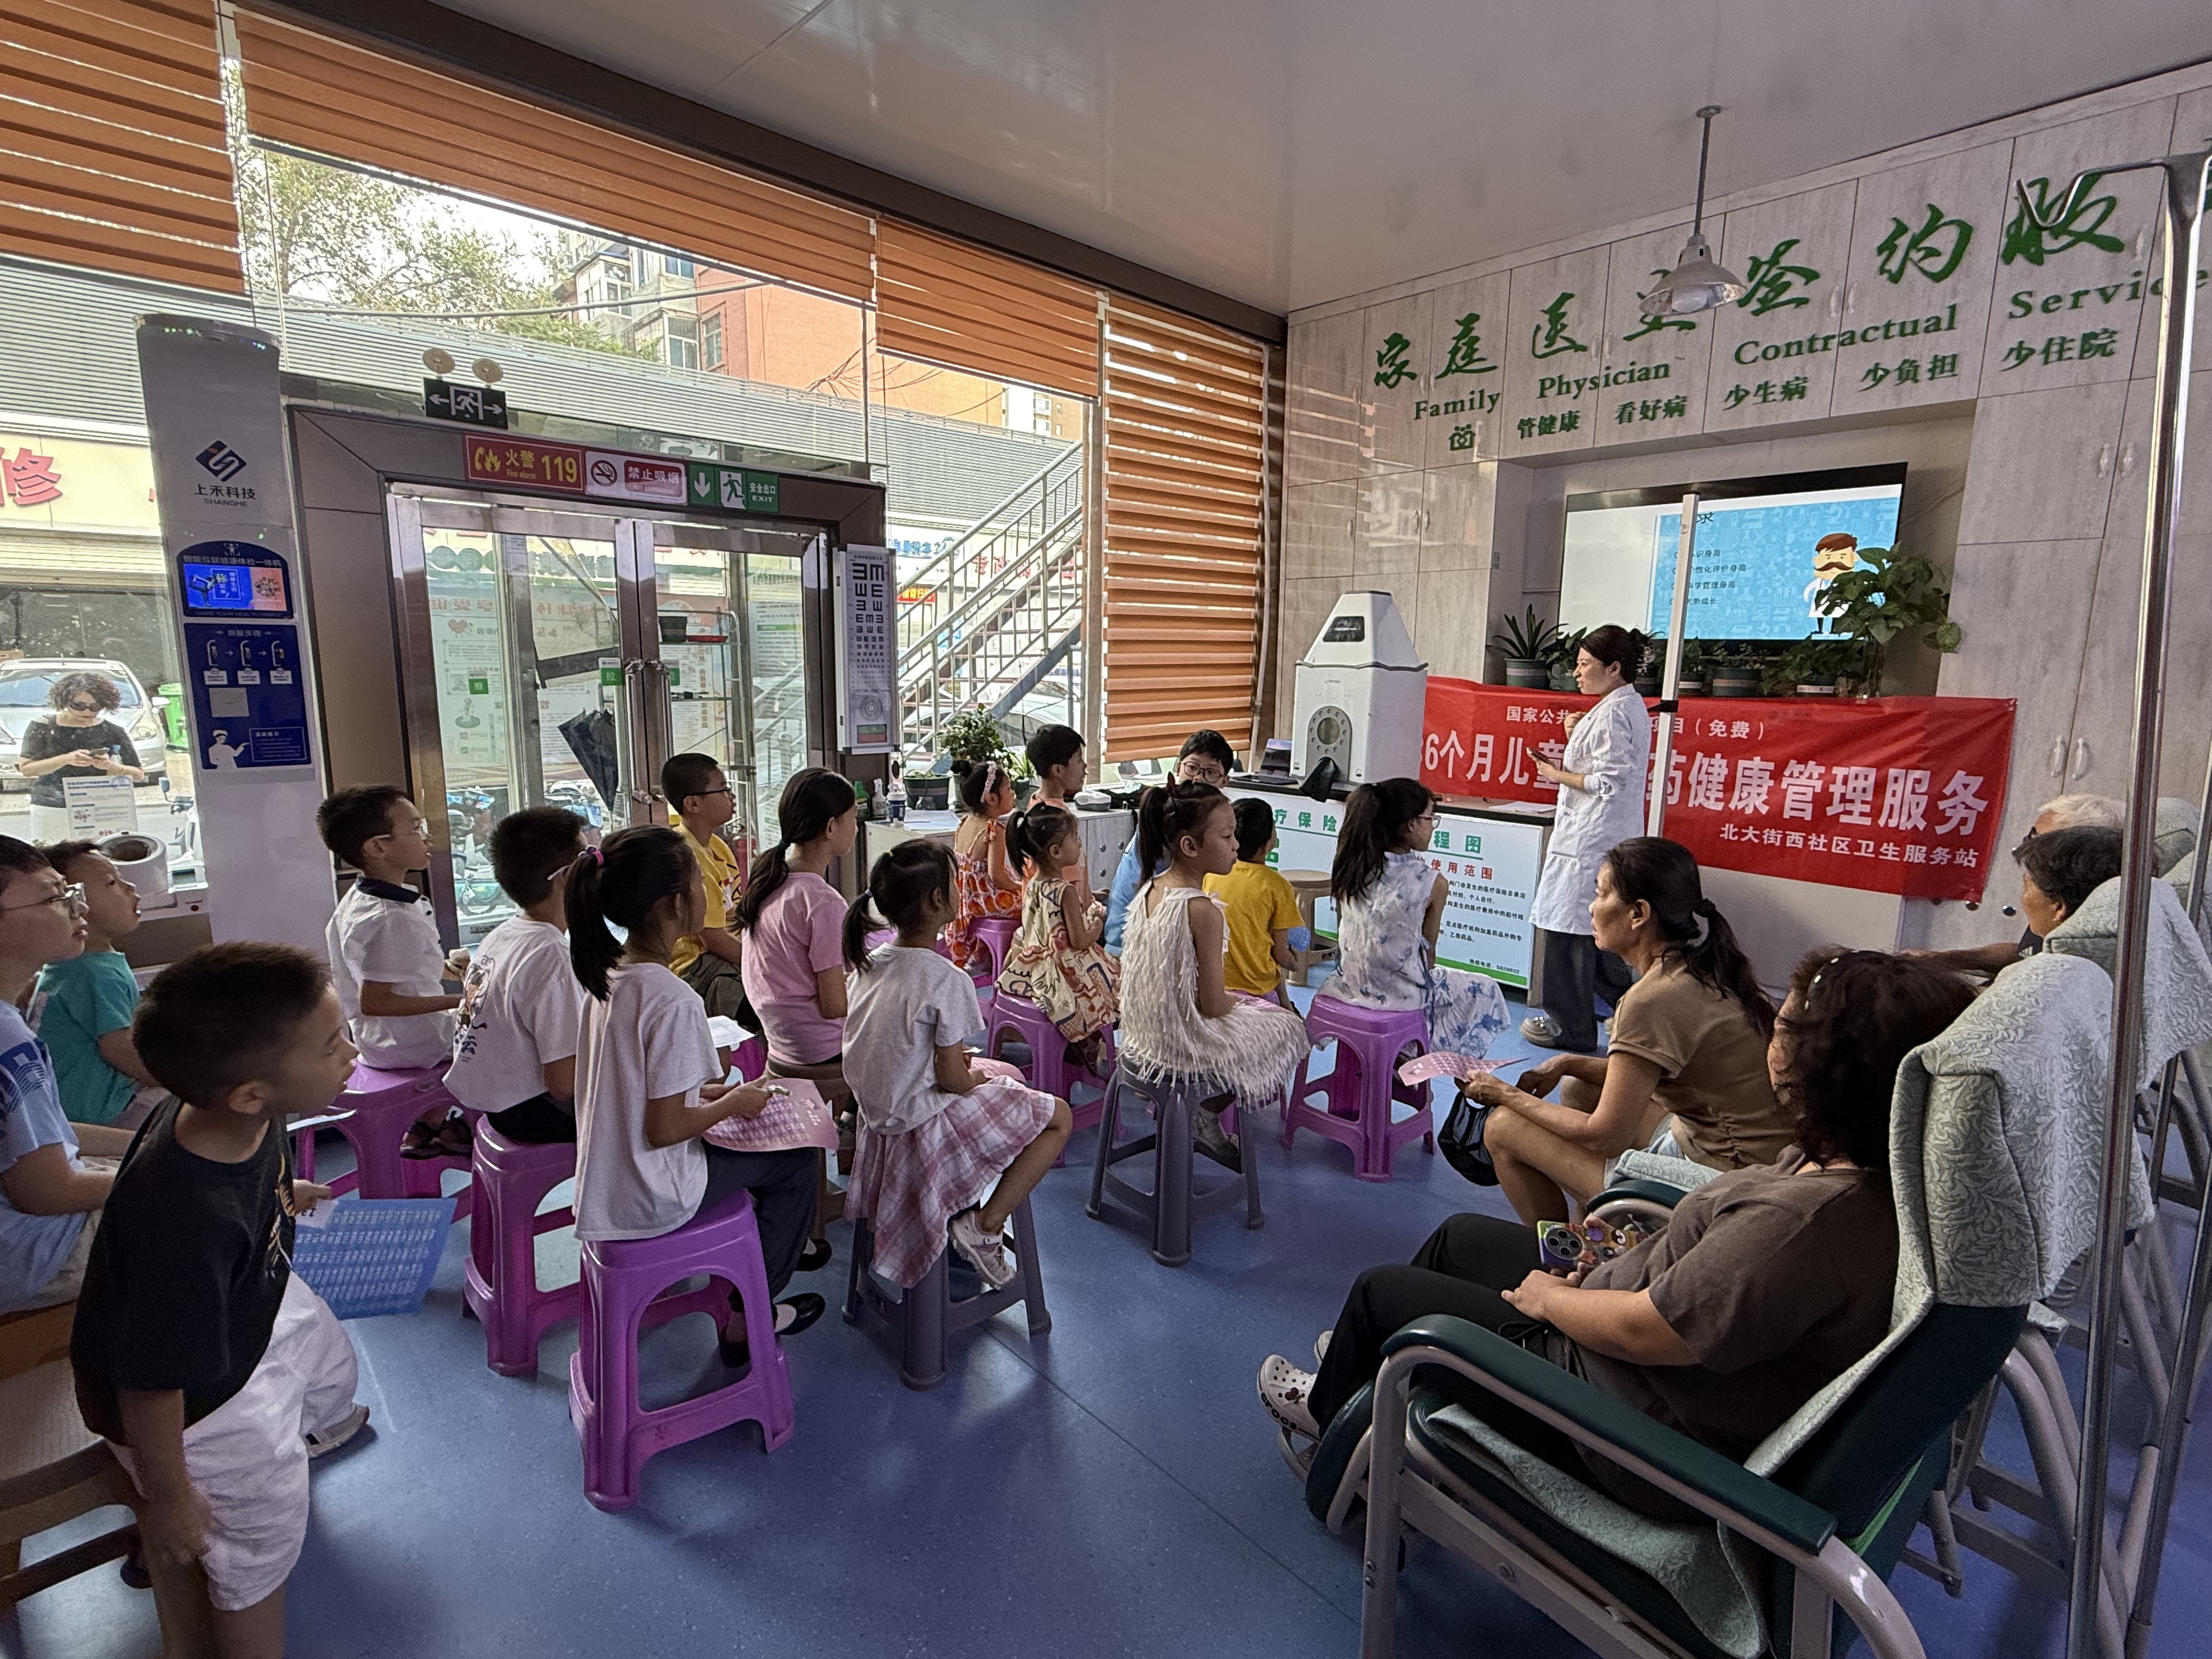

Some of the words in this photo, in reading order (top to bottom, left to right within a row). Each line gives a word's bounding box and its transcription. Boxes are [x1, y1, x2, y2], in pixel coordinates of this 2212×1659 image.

[1414, 388, 1501, 420] Family
[1537, 361, 1671, 400] Physician
[1734, 303, 1957, 365] Contractual
[1517, 410, 1580, 439] 管健康
[1615, 396, 1688, 425] 看好病
[1722, 375, 1809, 411] 少生病
[1859, 353, 1959, 392] 少负担
[1999, 328, 2118, 373] 少住院
[505, 448, 534, 469] 火警
[541, 455, 578, 483] 119
[0, 447, 63, 506] 修
[628, 466, 679, 484] 禁止吸烟
[194, 484, 256, 500] 上禾科技
[749, 483, 776, 494] 安全出口
[204, 498, 249, 507] SHANGHE
[1691, 564, 1747, 574] 性化评价身高
[1420, 730, 1565, 791] 6个月儿童
[1433, 830, 1482, 854] 程图
[1720, 823, 1979, 867] 北大街西社区卫生服务站
